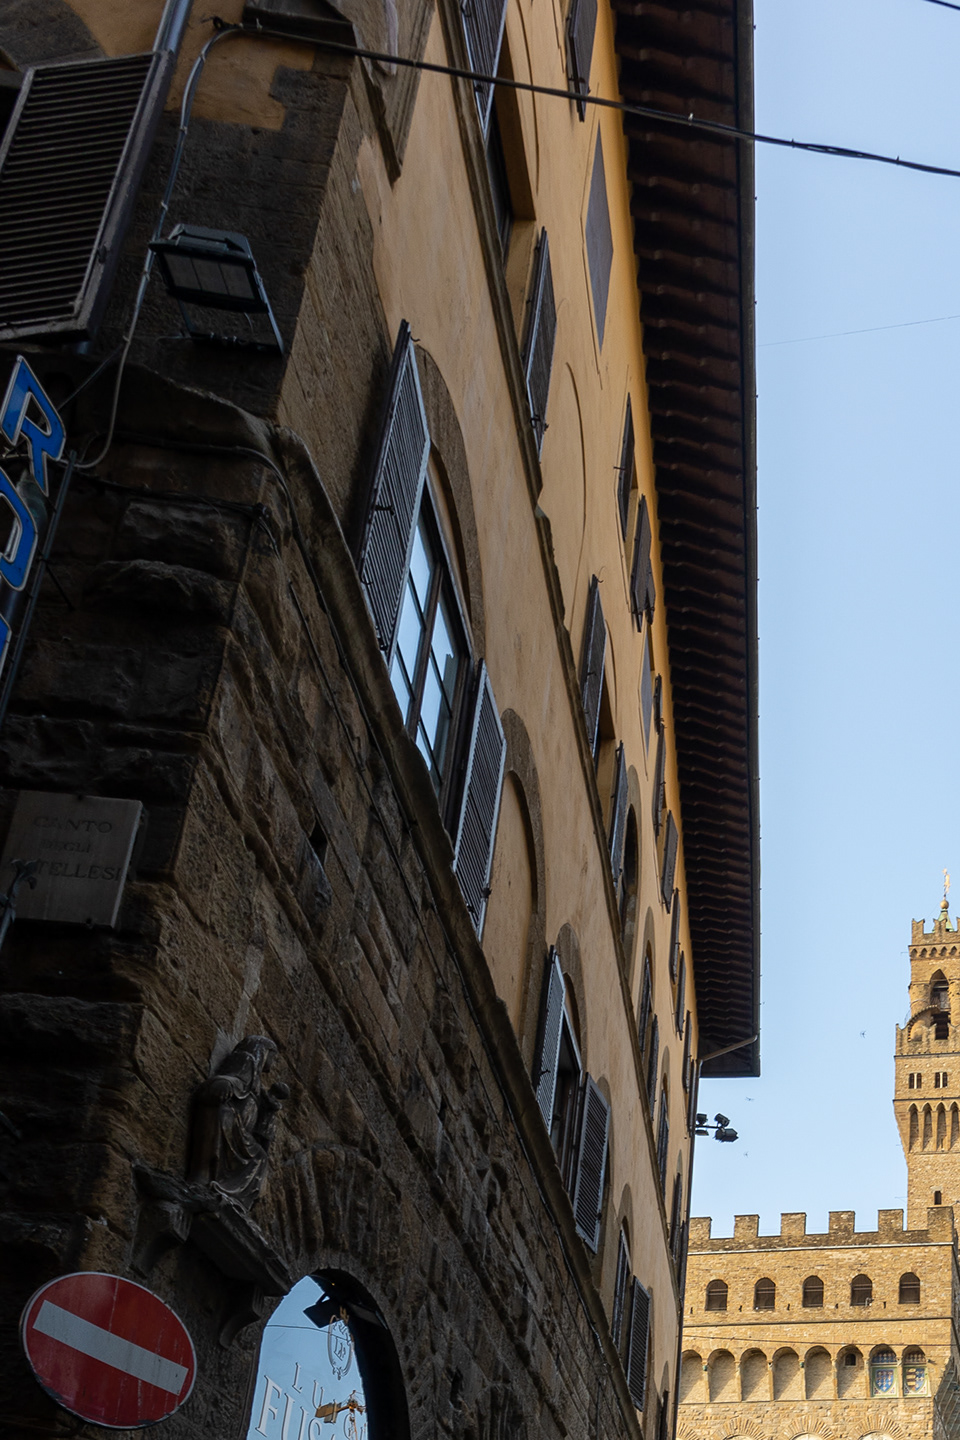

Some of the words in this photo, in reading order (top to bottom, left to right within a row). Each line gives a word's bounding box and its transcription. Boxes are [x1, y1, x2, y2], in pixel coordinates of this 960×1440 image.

[33, 815, 114, 835] CANTO
[41, 838, 92, 854] DEGLI
[28, 858, 122, 882] TELLESI
